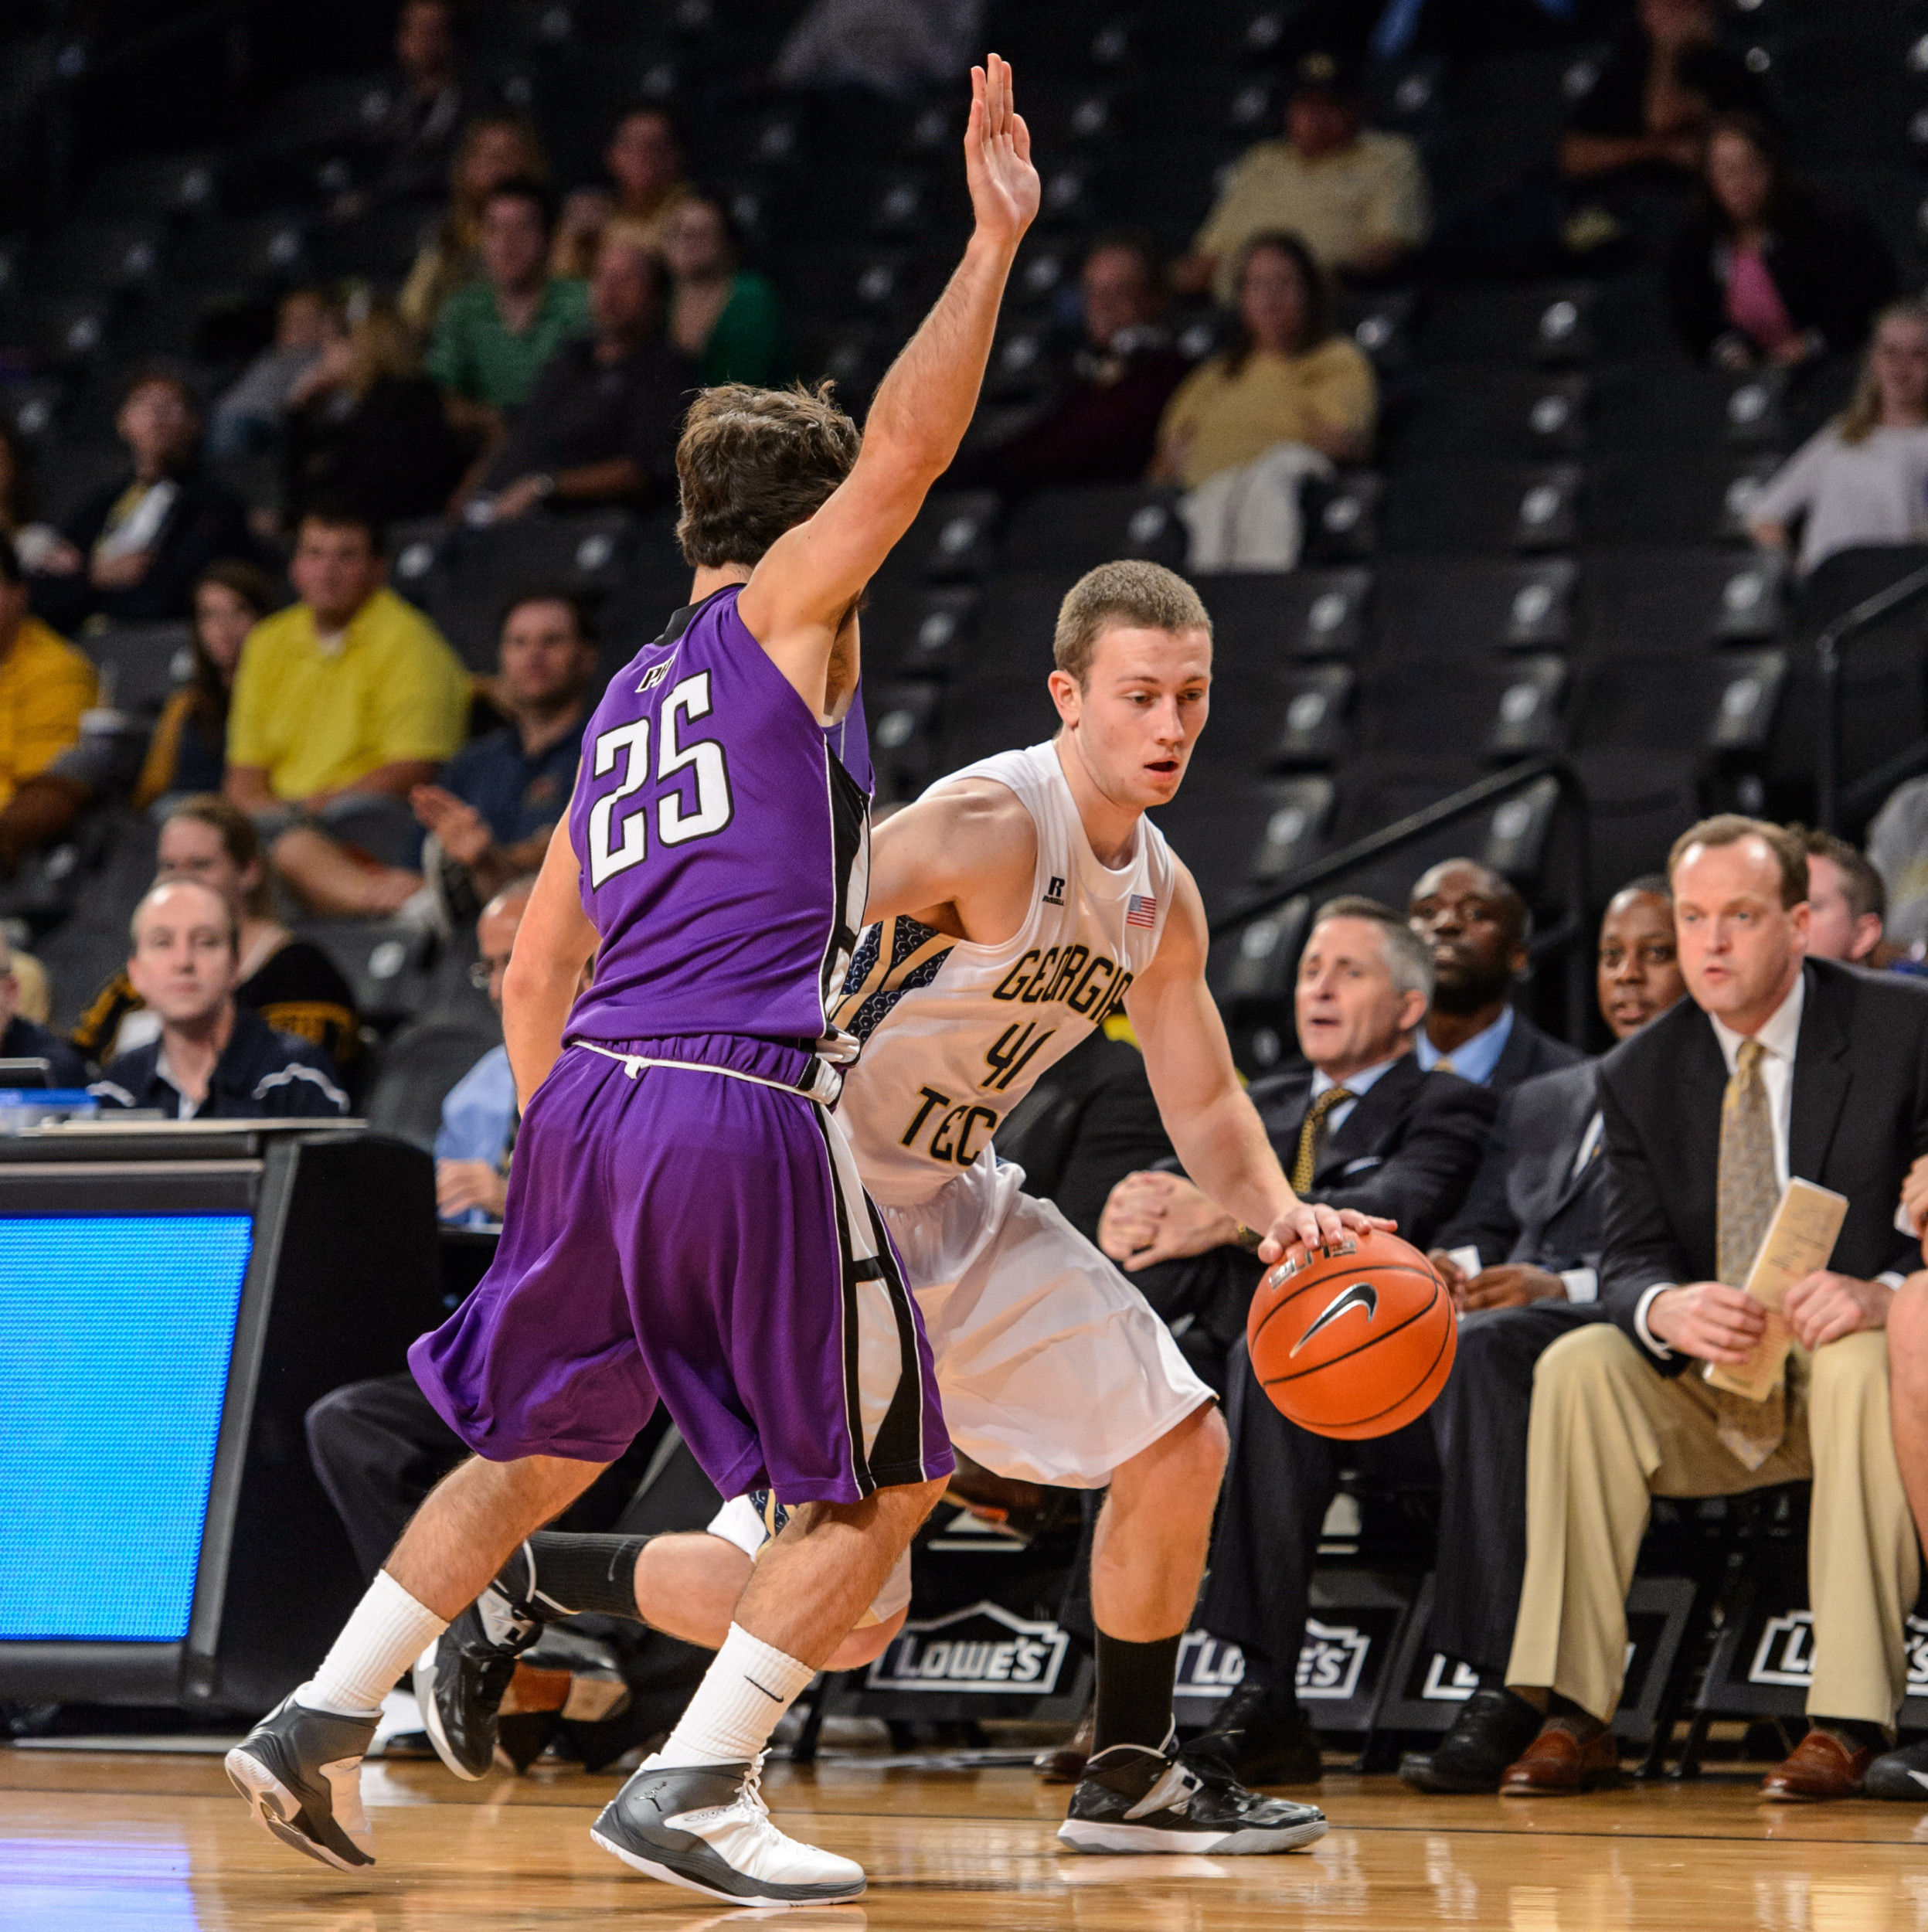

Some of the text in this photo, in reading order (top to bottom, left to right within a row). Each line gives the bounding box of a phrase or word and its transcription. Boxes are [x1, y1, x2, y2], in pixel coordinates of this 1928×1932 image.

[588, 668, 734, 894] 25
[1048, 876, 1066, 897] R
[981, 1021, 1056, 1090] 41
[899, 1087, 998, 1166] TEC
[893, 1635, 1046, 1682] LOWE'S
